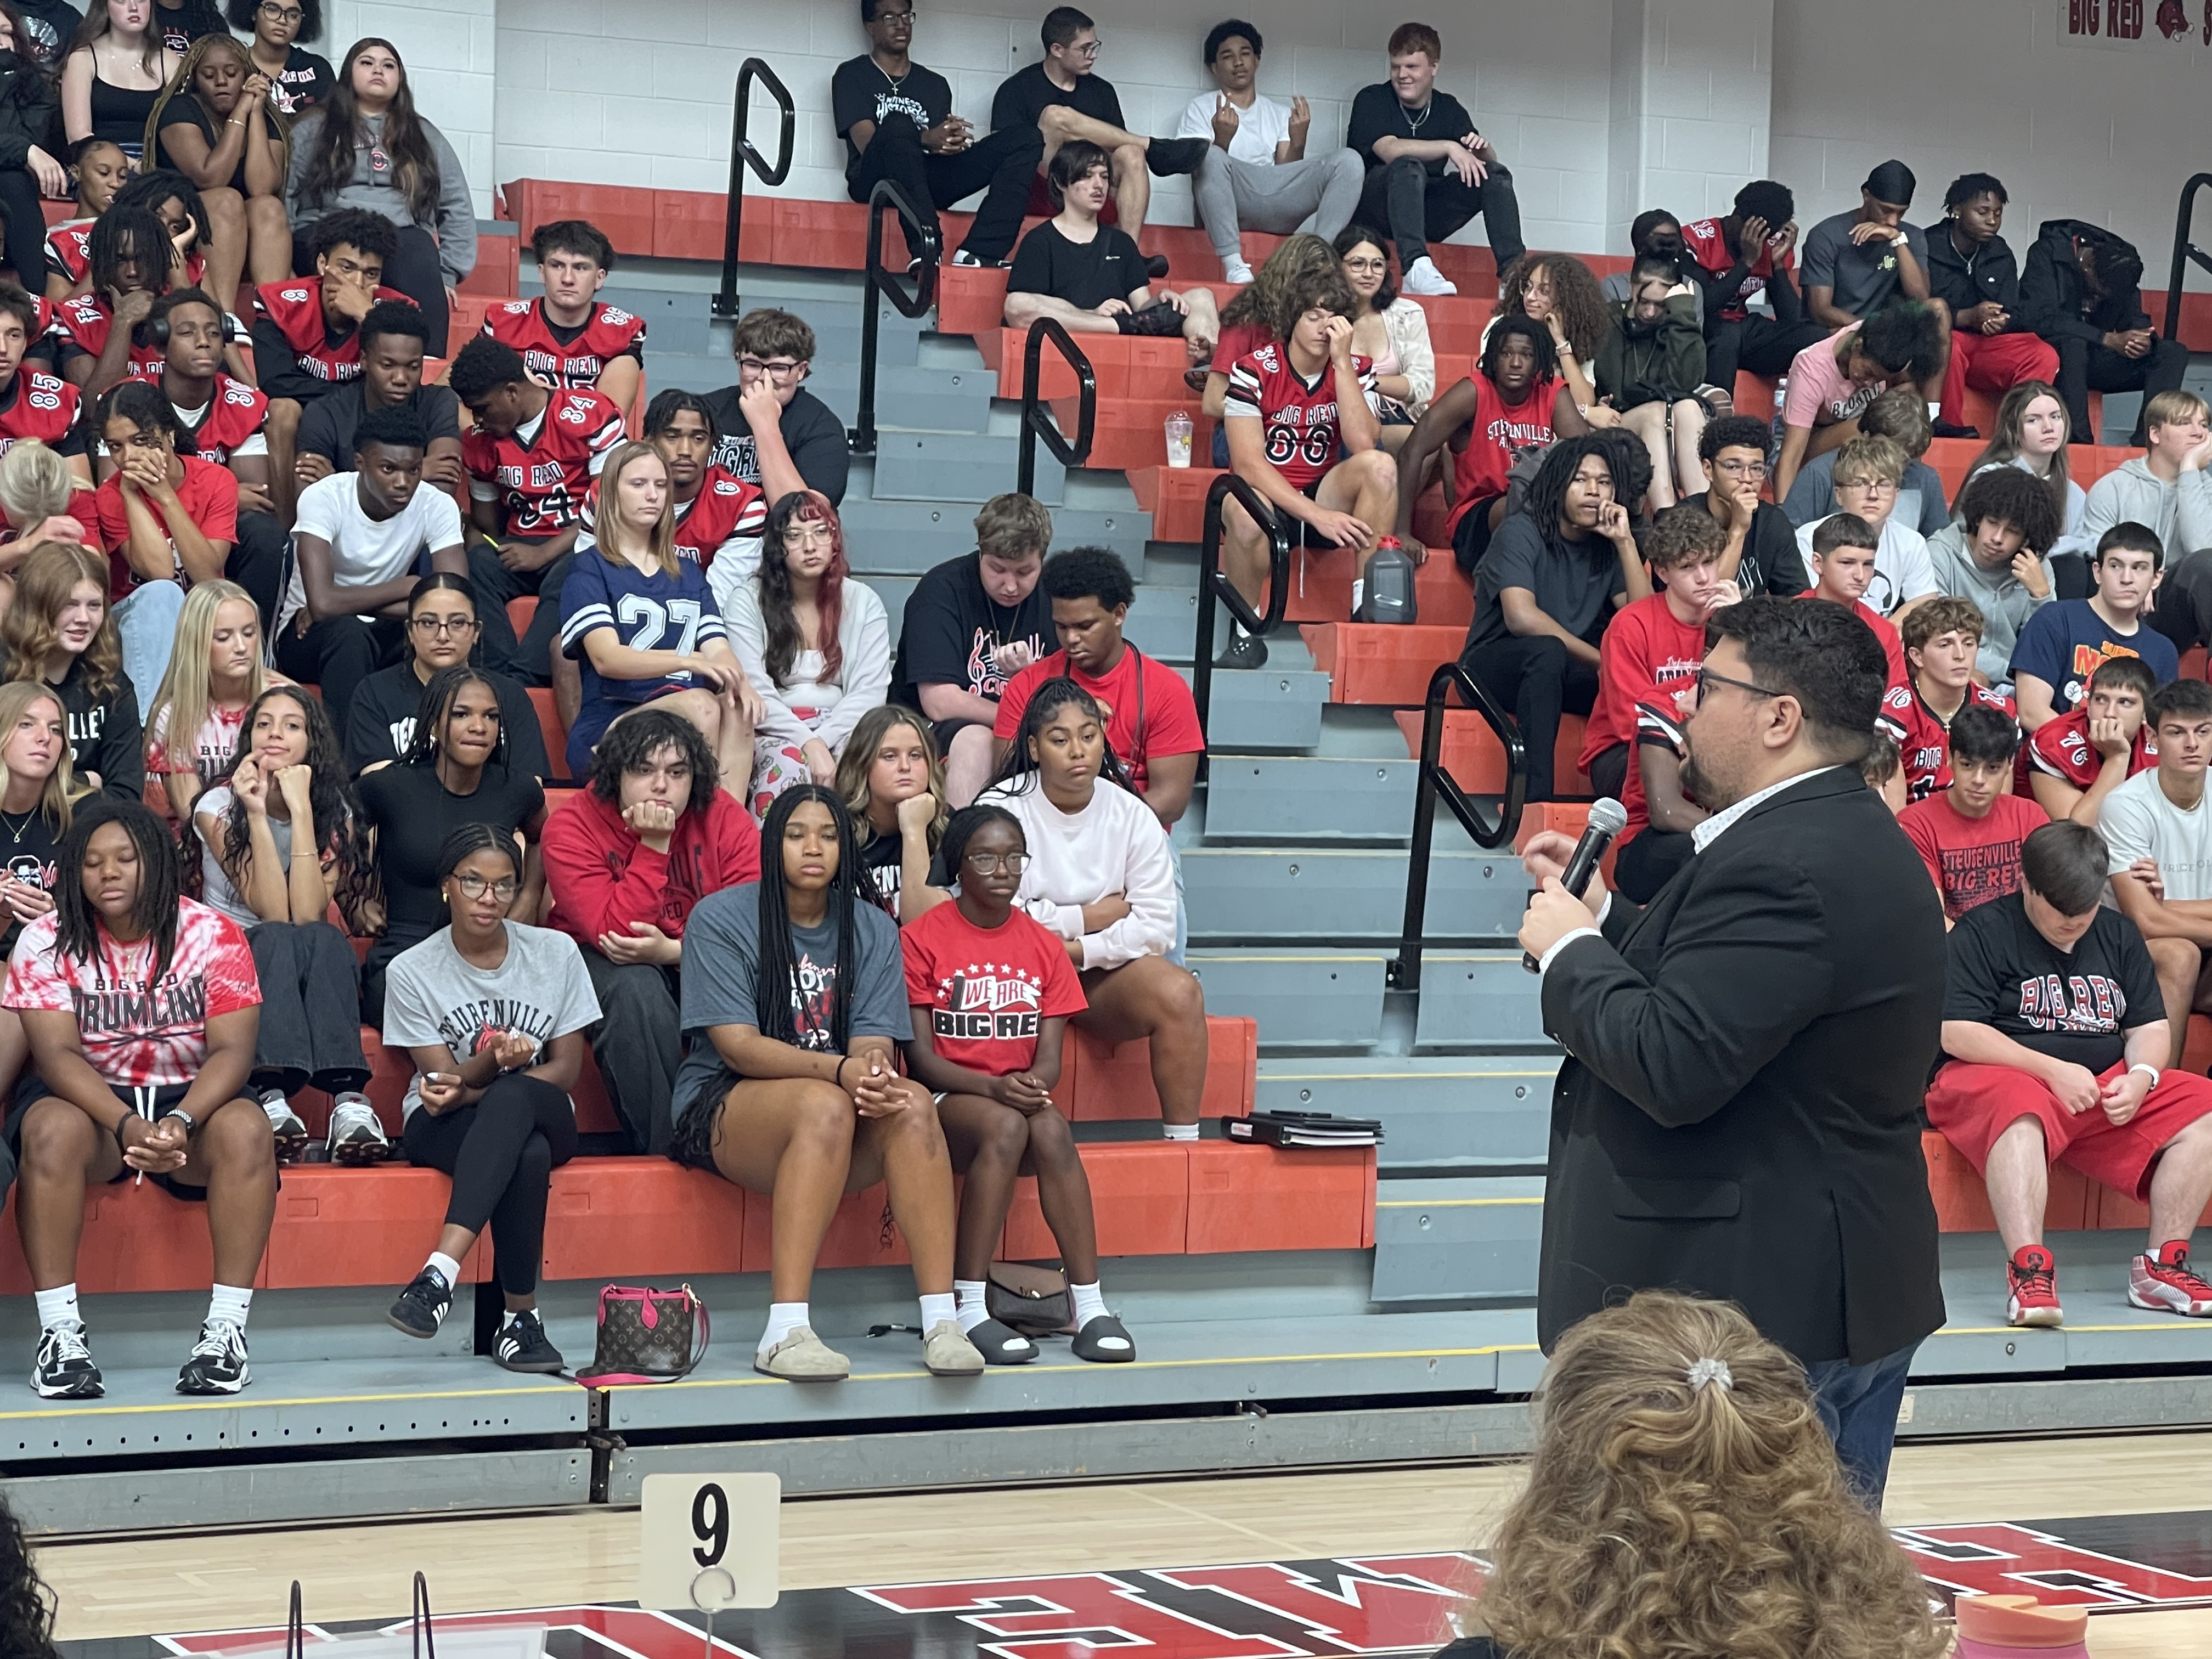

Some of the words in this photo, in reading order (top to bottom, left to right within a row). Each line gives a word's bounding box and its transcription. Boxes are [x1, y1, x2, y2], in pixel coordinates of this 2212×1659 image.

[2068, 0, 2100, 36] BIG
[2106, 0, 2143, 40] RED
[280, 289, 308, 302] 8
[297, 354, 328, 381] BIG
[525, 349, 557, 373] BIG
[563, 355, 601, 375] RED
[29, 372, 63, 410] 85
[559, 395, 597, 424] 34
[1271, 404, 1302, 425] BIG
[1305, 401, 1339, 426] RED
[498, 465, 523, 488] BIG
[531, 459, 566, 487] RED
[714, 479, 741, 496] 6
[617, 592, 701, 681] 27
[1884, 686, 1912, 709] 16
[200, 745, 231, 756] BIG
[1914, 747, 1943, 770] BIG
[2059, 730, 2089, 766] 76
[1942, 839, 2022, 871] STEUBENVILLE
[1944, 870, 1977, 891] BIG
[95, 978, 129, 991] BIG
[964, 978, 992, 1006] WE
[996, 980, 1028, 1006] ARE
[2018, 974, 2068, 1019] BIG
[2069, 974, 2127, 1022] RED
[437, 999, 553, 1051] STEUBENVILL
[933, 1008, 993, 1039] BIG
[994, 1008, 1042, 1040] RE
[691, 1482, 729, 1568] 9
